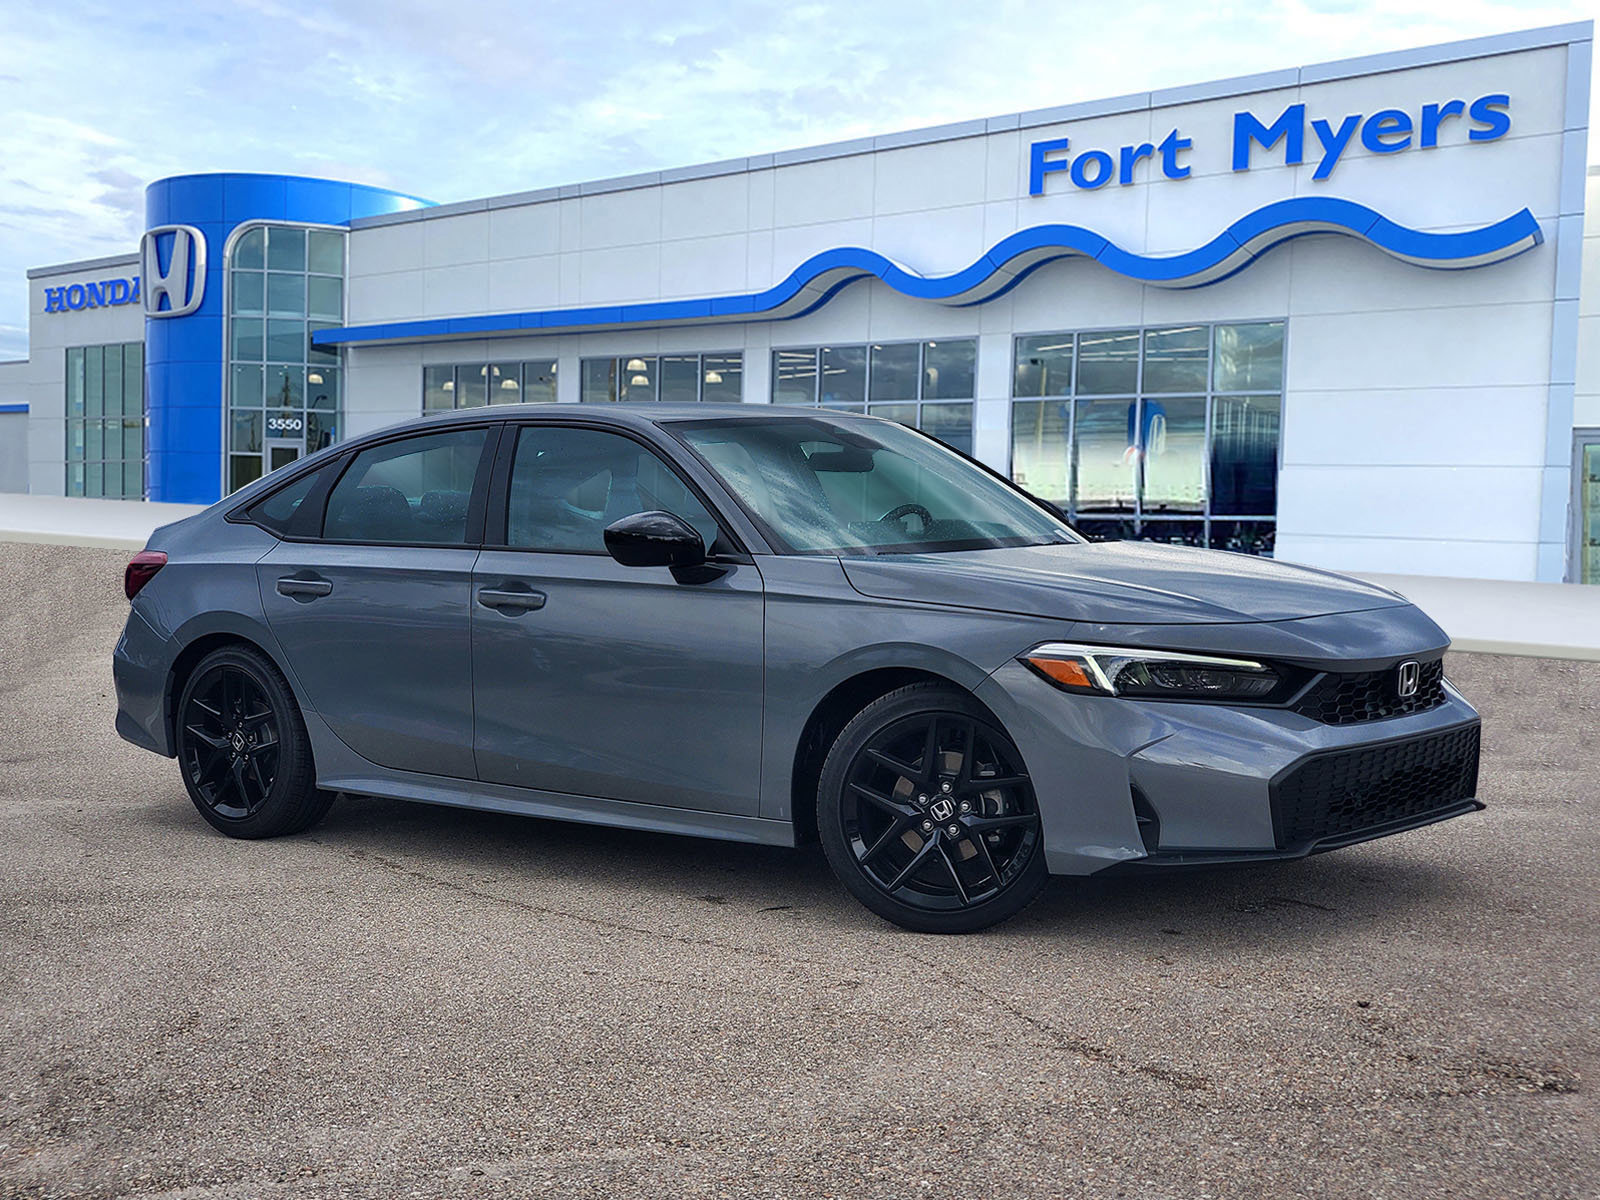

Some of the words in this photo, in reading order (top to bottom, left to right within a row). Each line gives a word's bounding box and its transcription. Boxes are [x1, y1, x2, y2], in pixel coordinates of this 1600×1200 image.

[1029, 127, 1193, 197] Fort
[1232, 93, 1512, 183] Myers
[268, 418, 302, 430] 3550
